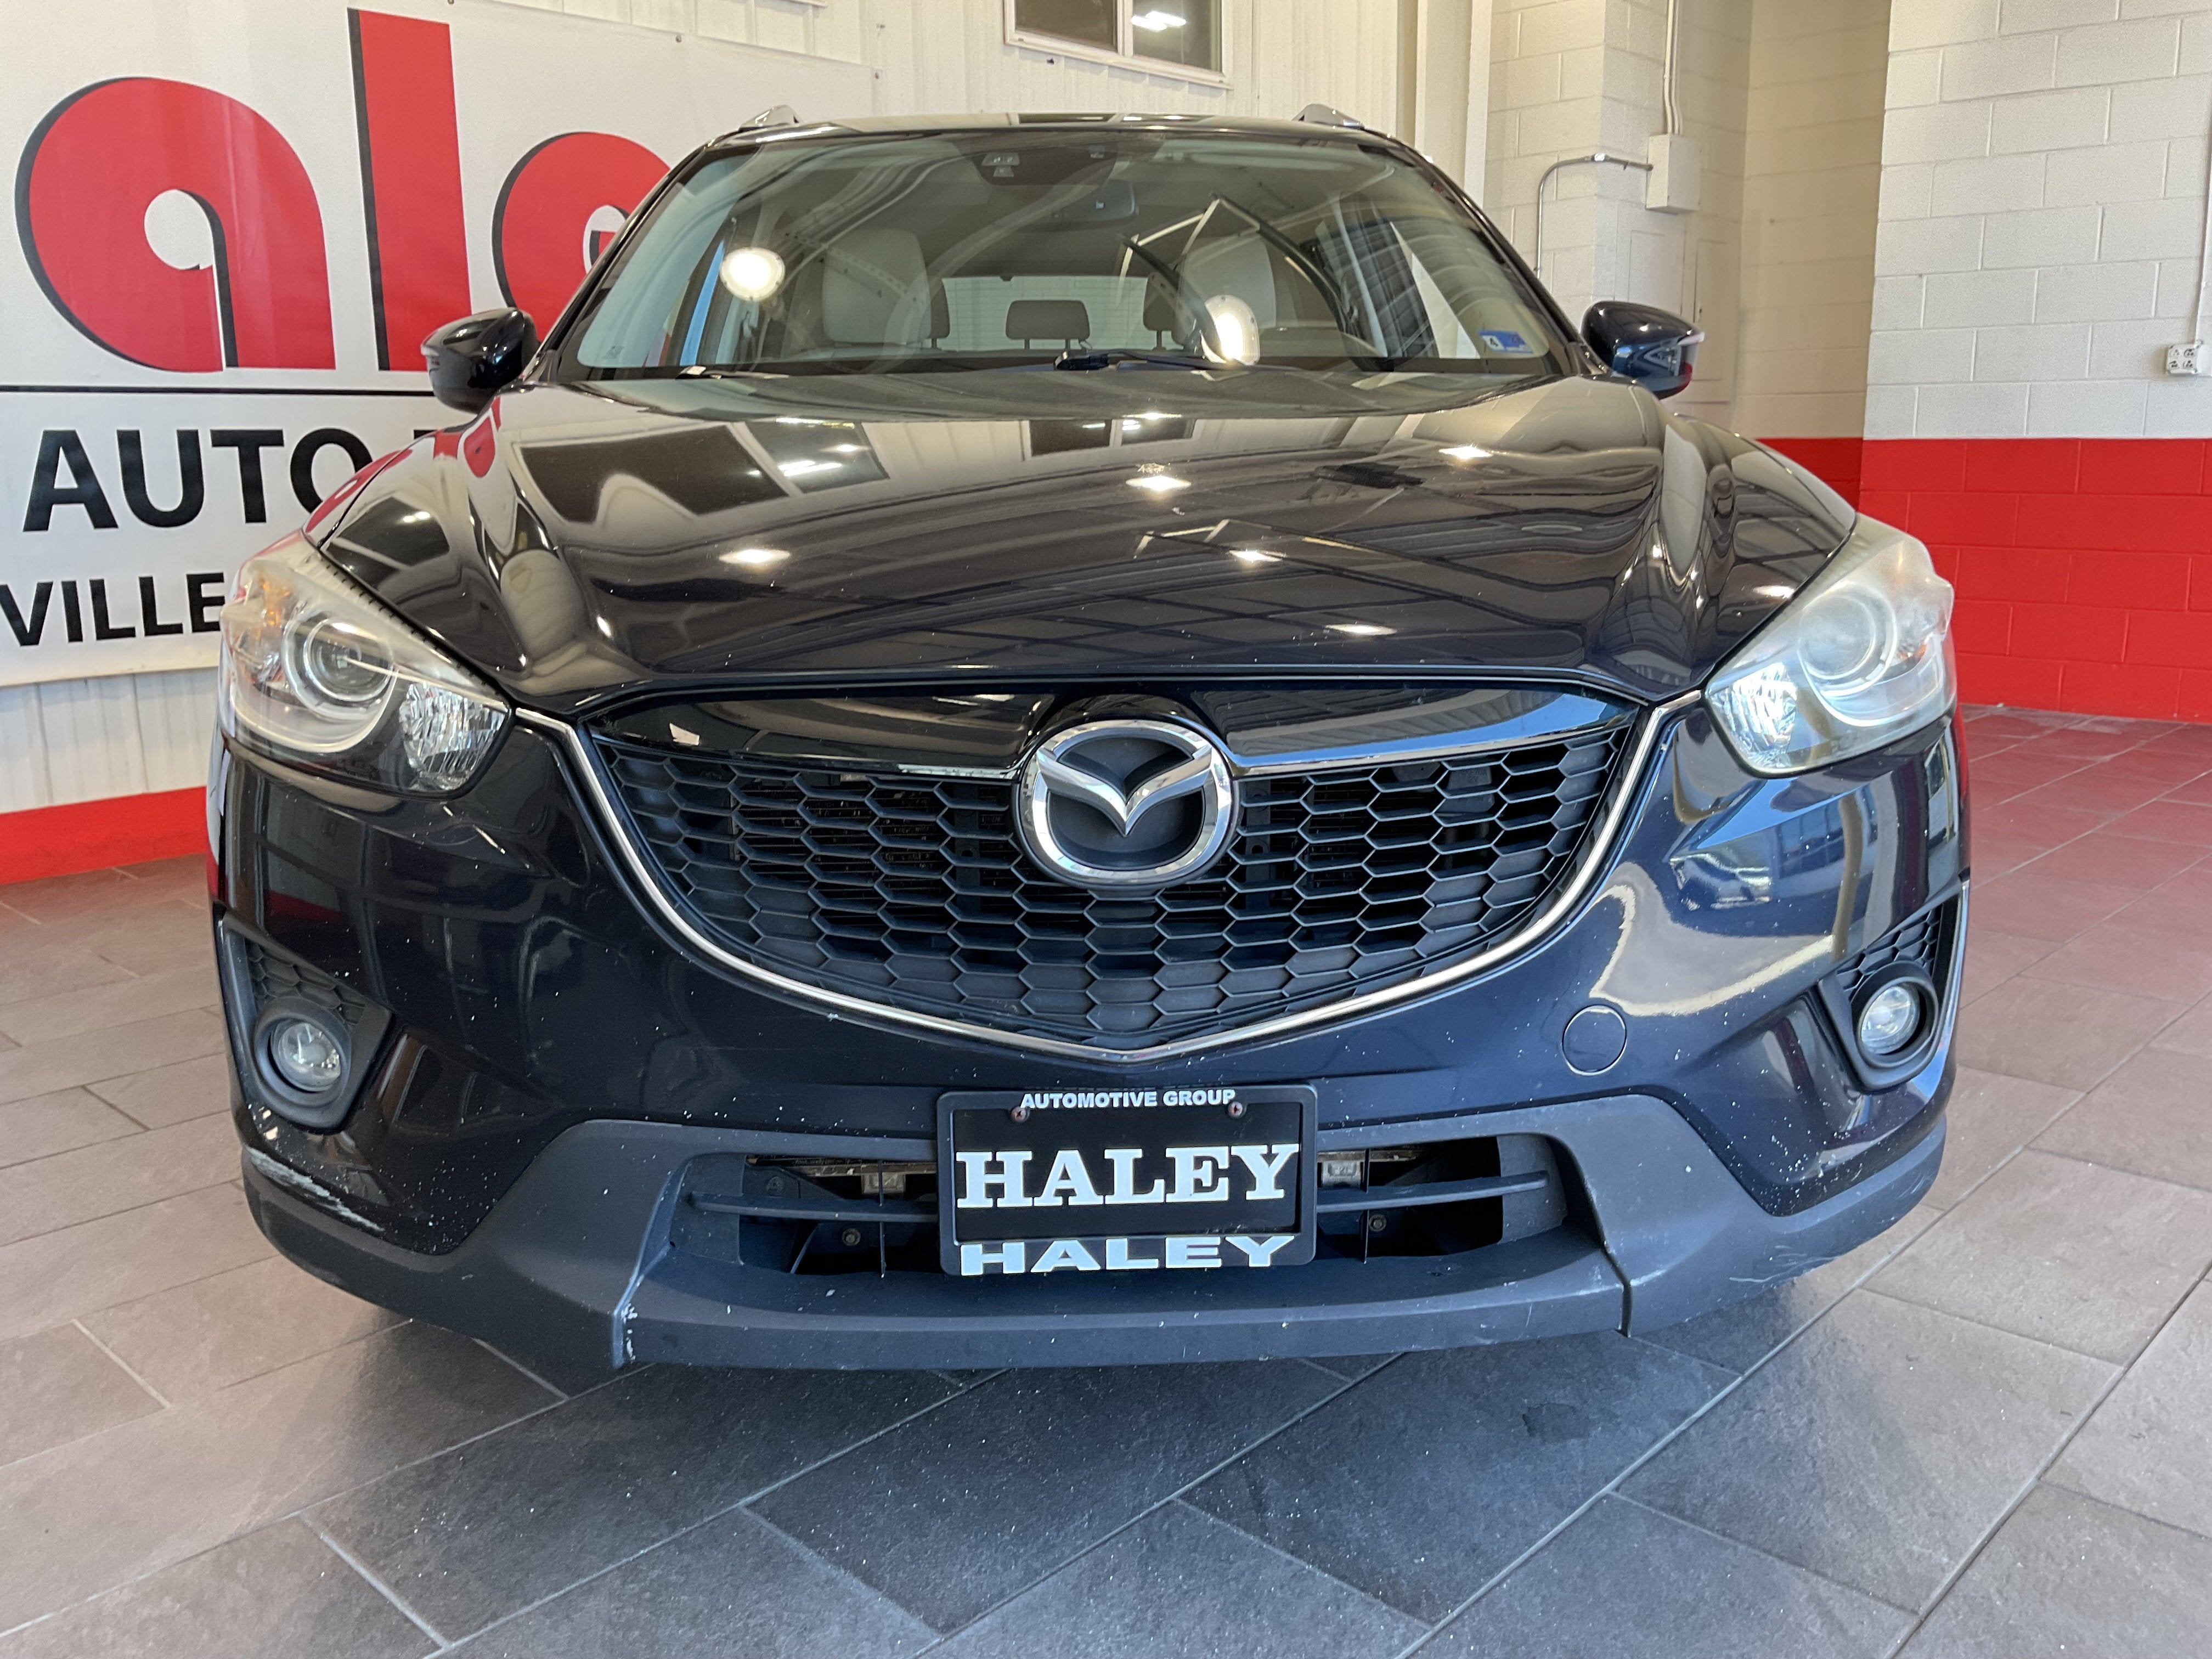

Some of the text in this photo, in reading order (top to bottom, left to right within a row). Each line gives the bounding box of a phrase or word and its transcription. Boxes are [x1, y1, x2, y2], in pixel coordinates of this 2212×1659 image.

[23, 428, 373, 532] AUTO
[0, 573, 224, 646] VILLE
[1020, 1089, 1236, 1109] AUTOMOTIVE GROUP
[956, 1143, 1299, 1208] HALEY
[961, 1235, 1294, 1276] HALEY
